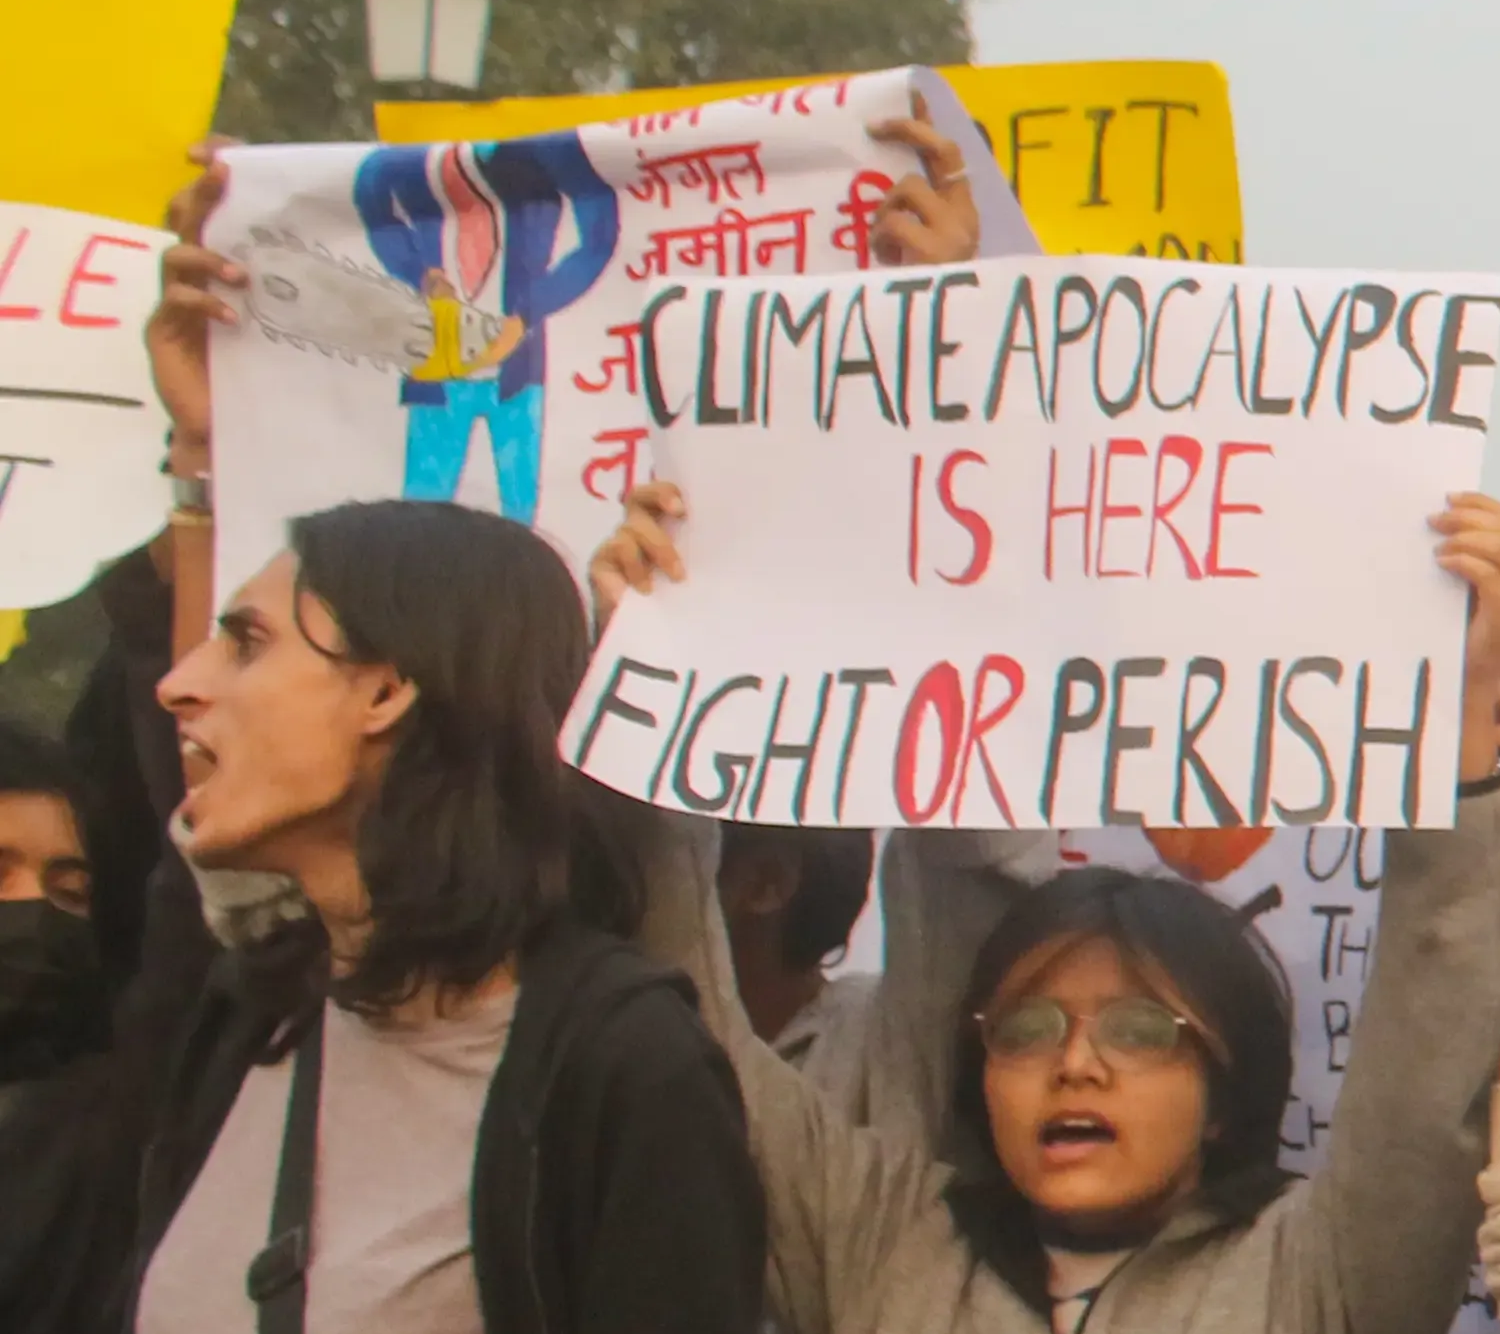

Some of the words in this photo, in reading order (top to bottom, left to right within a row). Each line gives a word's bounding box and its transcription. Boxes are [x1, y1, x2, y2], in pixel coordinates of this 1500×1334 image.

[625, 139, 768, 210] जंगल
[640, 271, 982, 433] CLIMATE
[906, 449, 994, 585] IS
[1044, 437, 1276, 584] HERE
[575, 655, 896, 827] FIGHT
[892, 652, 1025, 829] OR
[1037, 655, 1430, 829] PERISH
